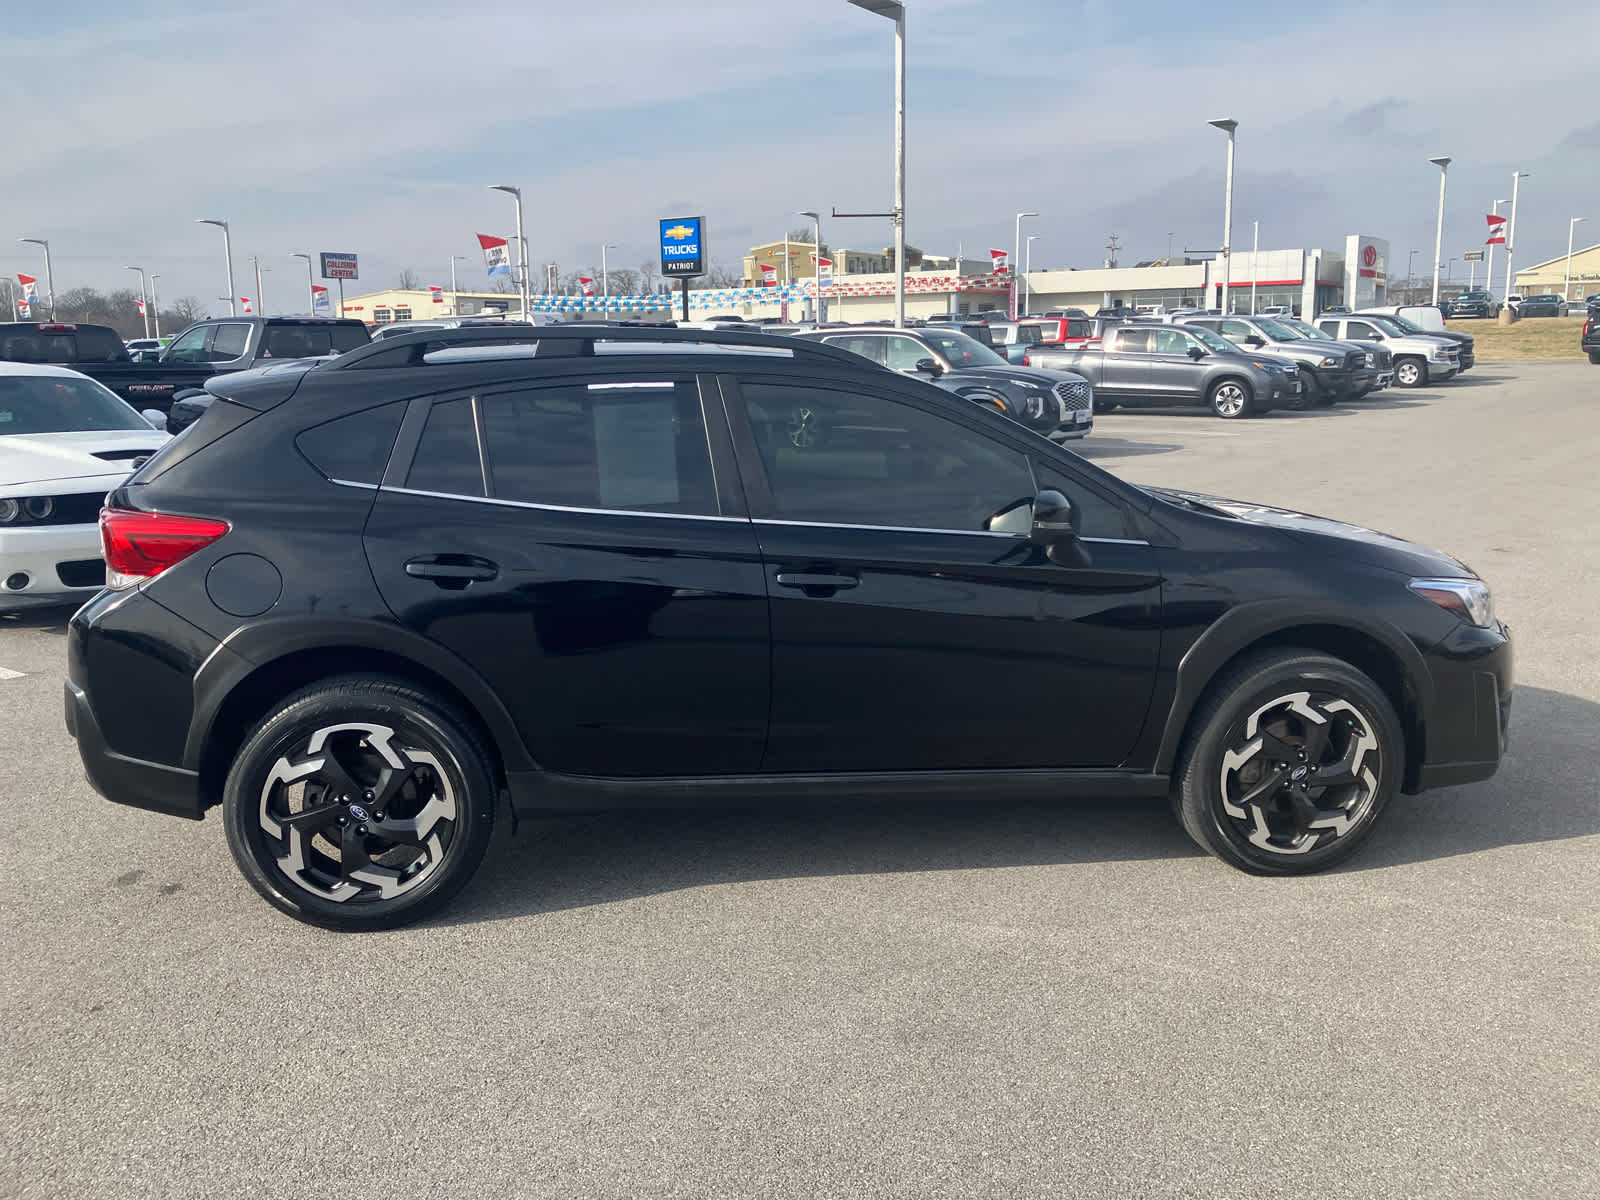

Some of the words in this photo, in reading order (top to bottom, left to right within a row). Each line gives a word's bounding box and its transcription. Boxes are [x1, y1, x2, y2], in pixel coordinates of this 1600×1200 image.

[663, 244, 698, 256] TRUCKS
[327, 260, 356, 269] COLLISION
[667, 262, 694, 270] PATRIOT
[331, 269, 354, 277] CENTER
